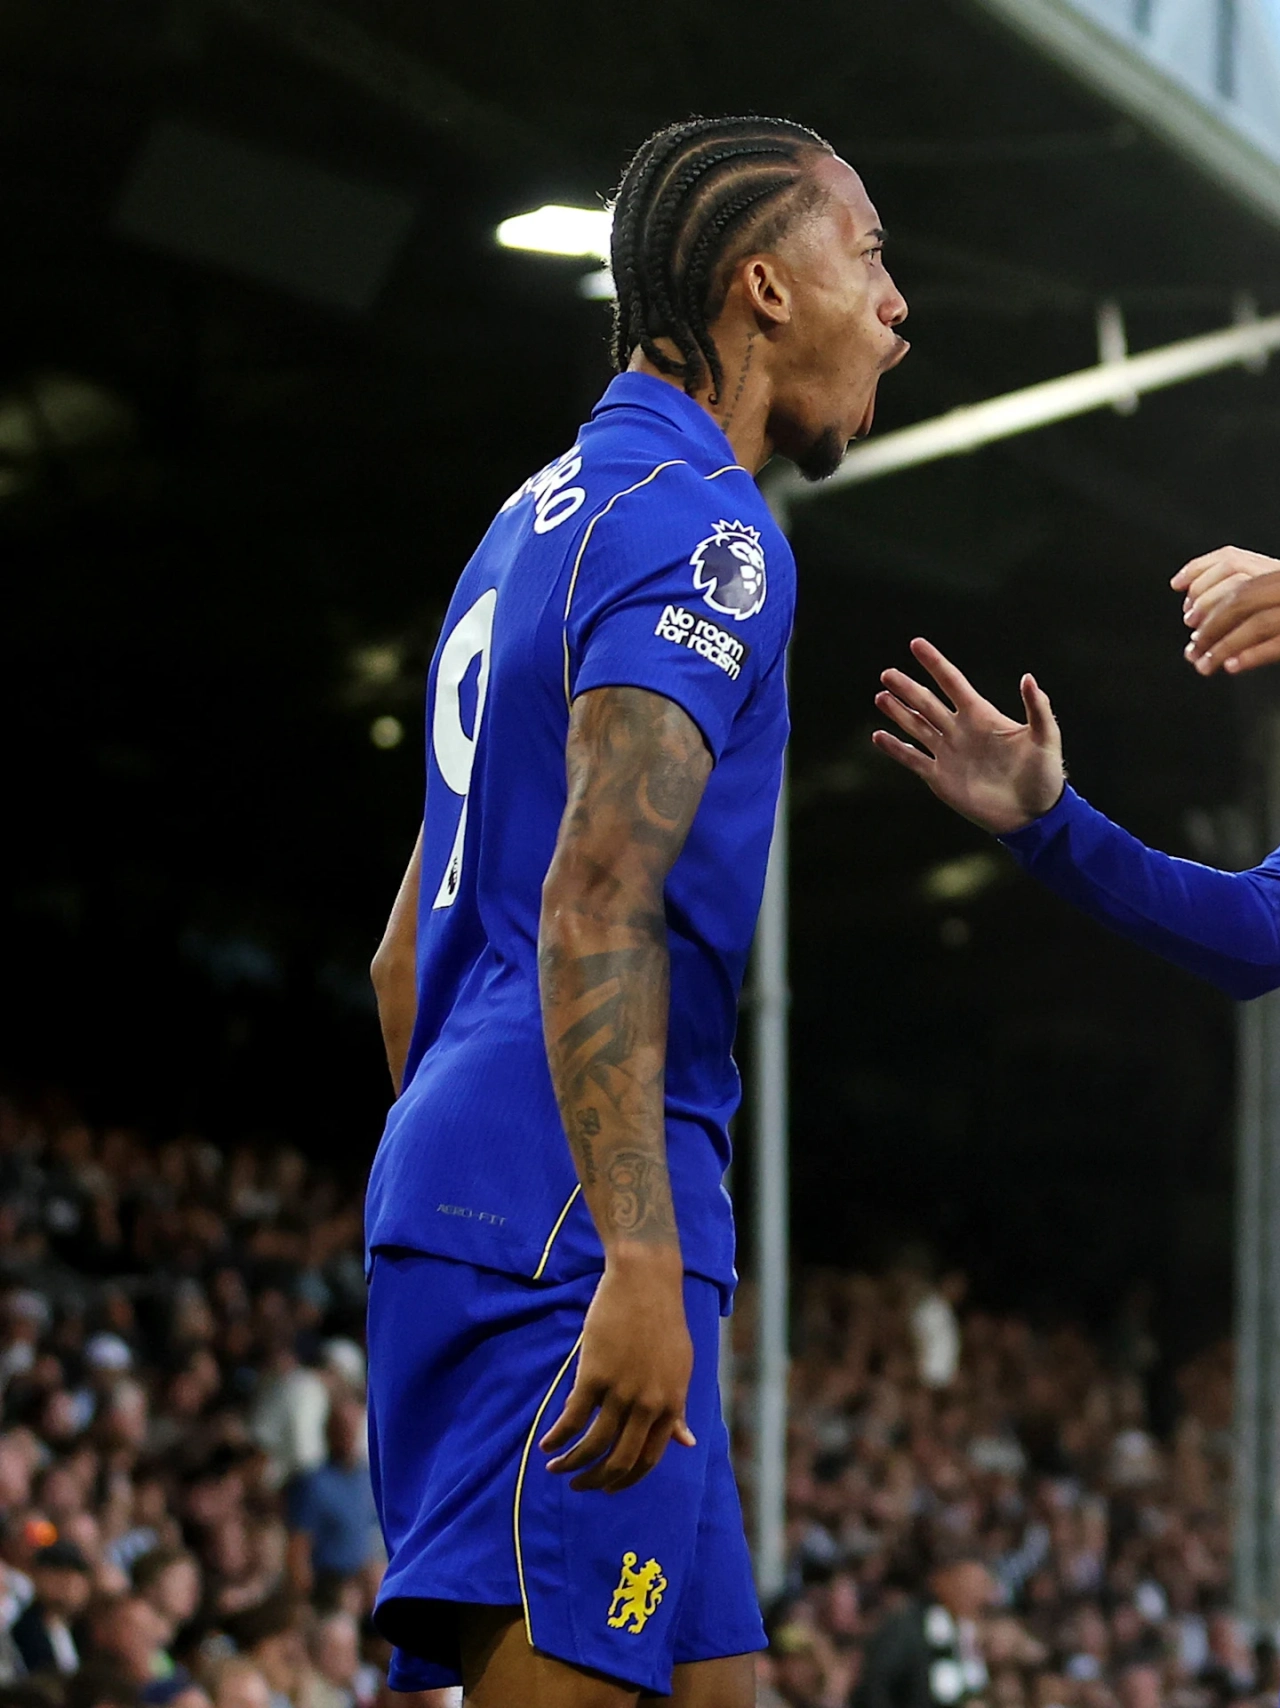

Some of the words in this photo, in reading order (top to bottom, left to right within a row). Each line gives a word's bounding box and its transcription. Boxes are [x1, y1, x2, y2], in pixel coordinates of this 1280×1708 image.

[660, 605, 695, 630] No
[694, 620, 744, 661] room
[687, 634, 741, 681] racism
[433, 587, 497, 910] 9
